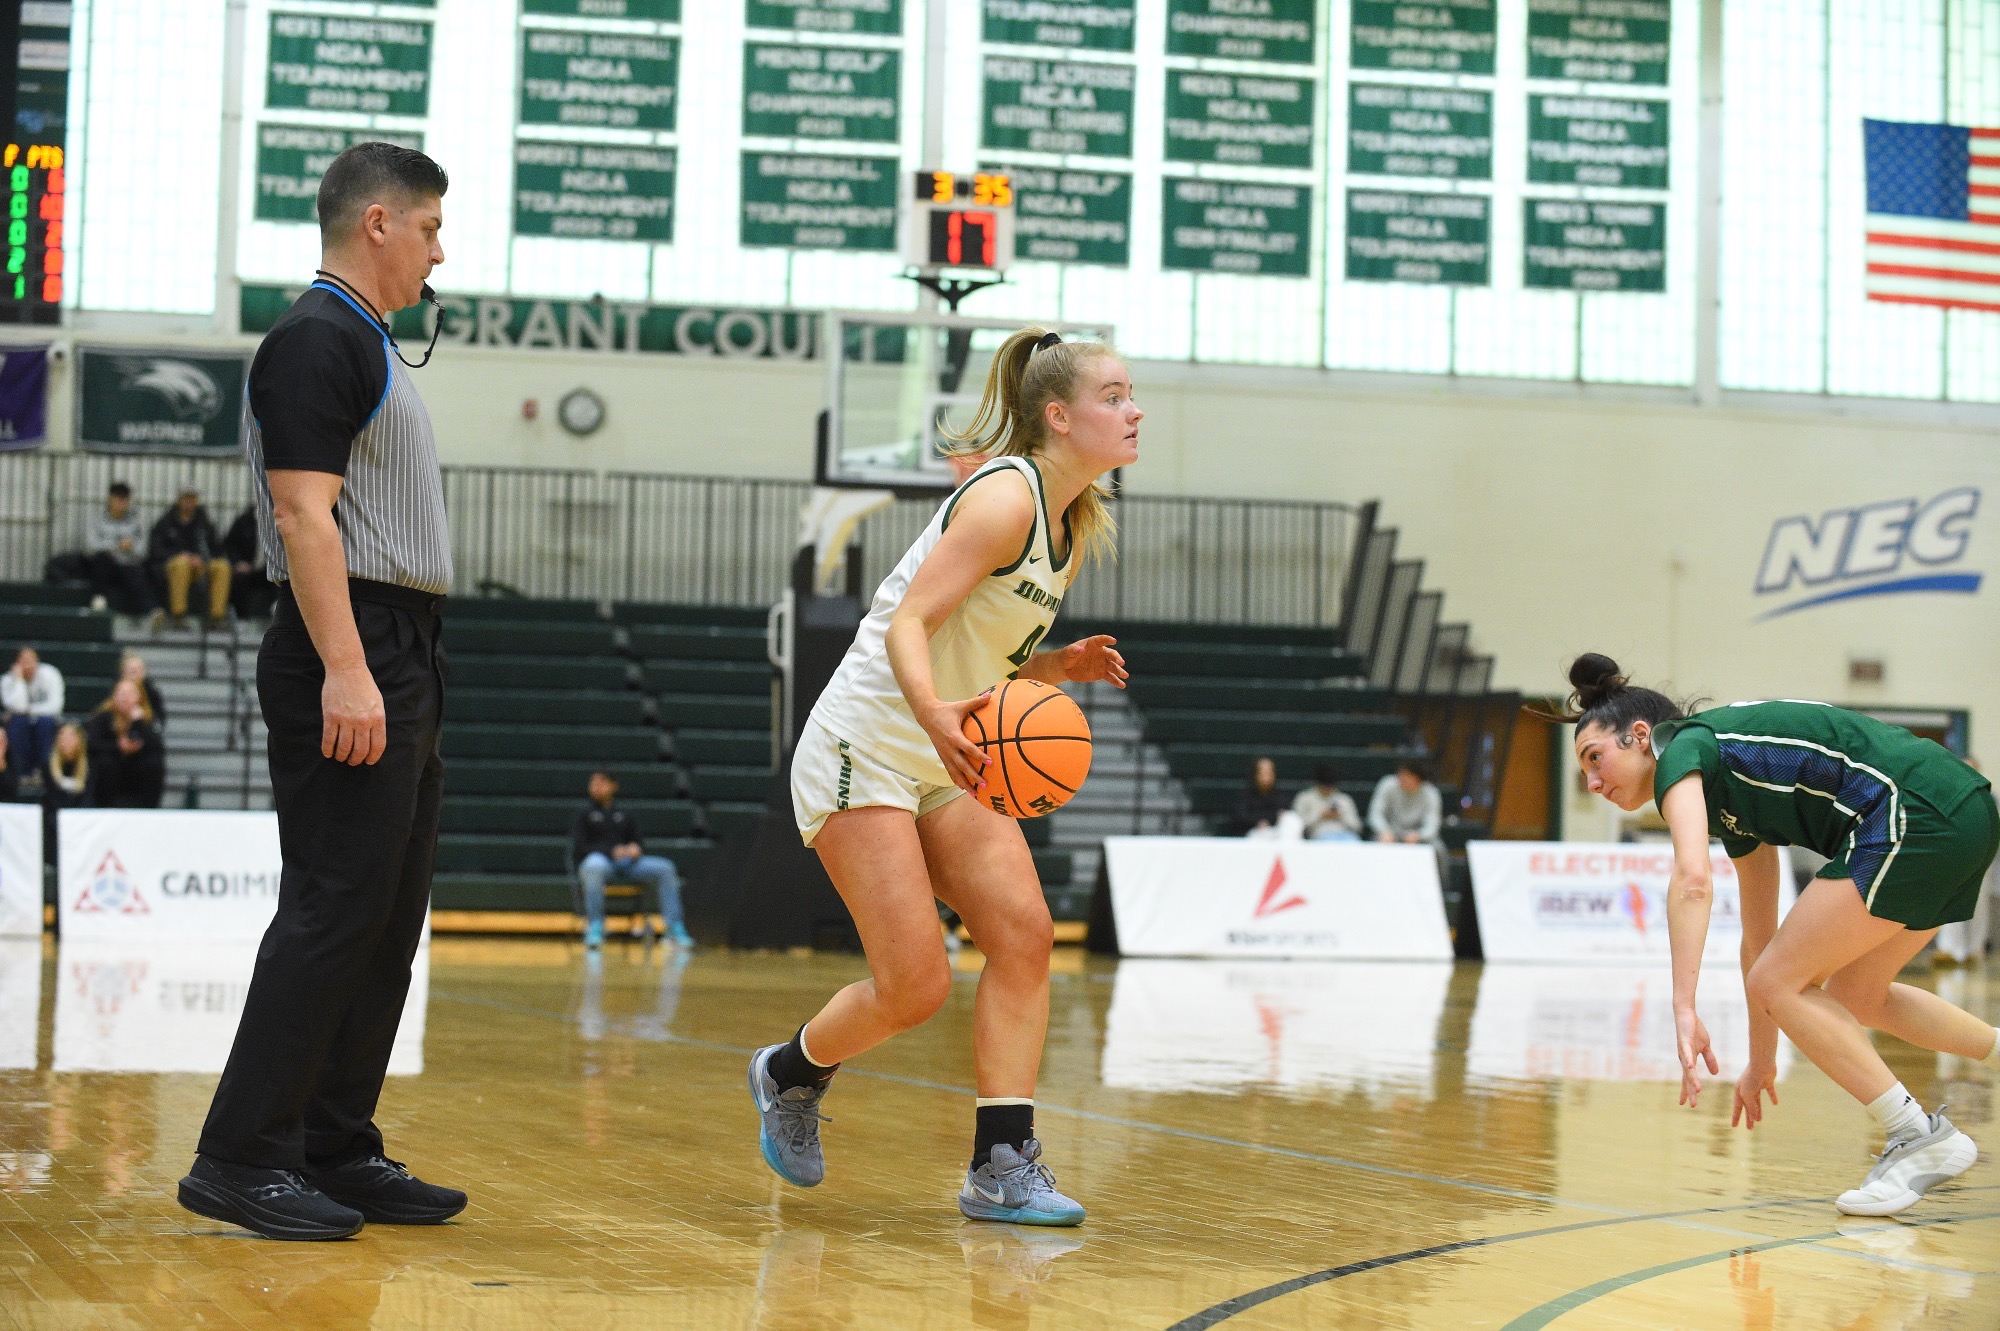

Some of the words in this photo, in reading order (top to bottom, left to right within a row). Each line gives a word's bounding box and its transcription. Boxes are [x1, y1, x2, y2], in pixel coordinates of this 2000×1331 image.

[315, 41, 384, 64] NCAA
[272, 62, 425, 91] TOURNAMENT
[567, 57, 632, 79] NCAA
[525, 78, 673, 107] TOURNAMENT
[787, 71, 855, 92] NCAA
[749, 90, 894, 119] CHAMPIONSHIPS
[1020, 84, 1096, 109] NCAA
[1207, 100, 1271, 121] NCAA
[1390, 110, 1451, 132] NCAA
[1168, 118, 1311, 146] TOURNAMENT
[1351, 129, 1490, 158] TOURNAMENT
[1568, 119, 1628, 143] NCAA
[1530, 140, 1667, 168] TOURNAMENT
[560, 170, 627, 192] NCAA
[785, 181, 852, 201] NCAA
[518, 190, 671, 220] TOURNAMENT
[746, 202, 893, 229] TOURNAMENT
[1021, 193, 1086, 216] NCAA
[1205, 206, 1269, 229] NCAA
[948, 211, 995, 266] 17
[1386, 215, 1448, 238] NCAA
[1563, 225, 1624, 247] NCAA
[1350, 235, 1487, 264] TOURNAMENT
[1526, 244, 1663, 272] TOURNAMENT
[423, 298, 649, 353] GRANT
[1754, 487, 1981, 595] NEC
